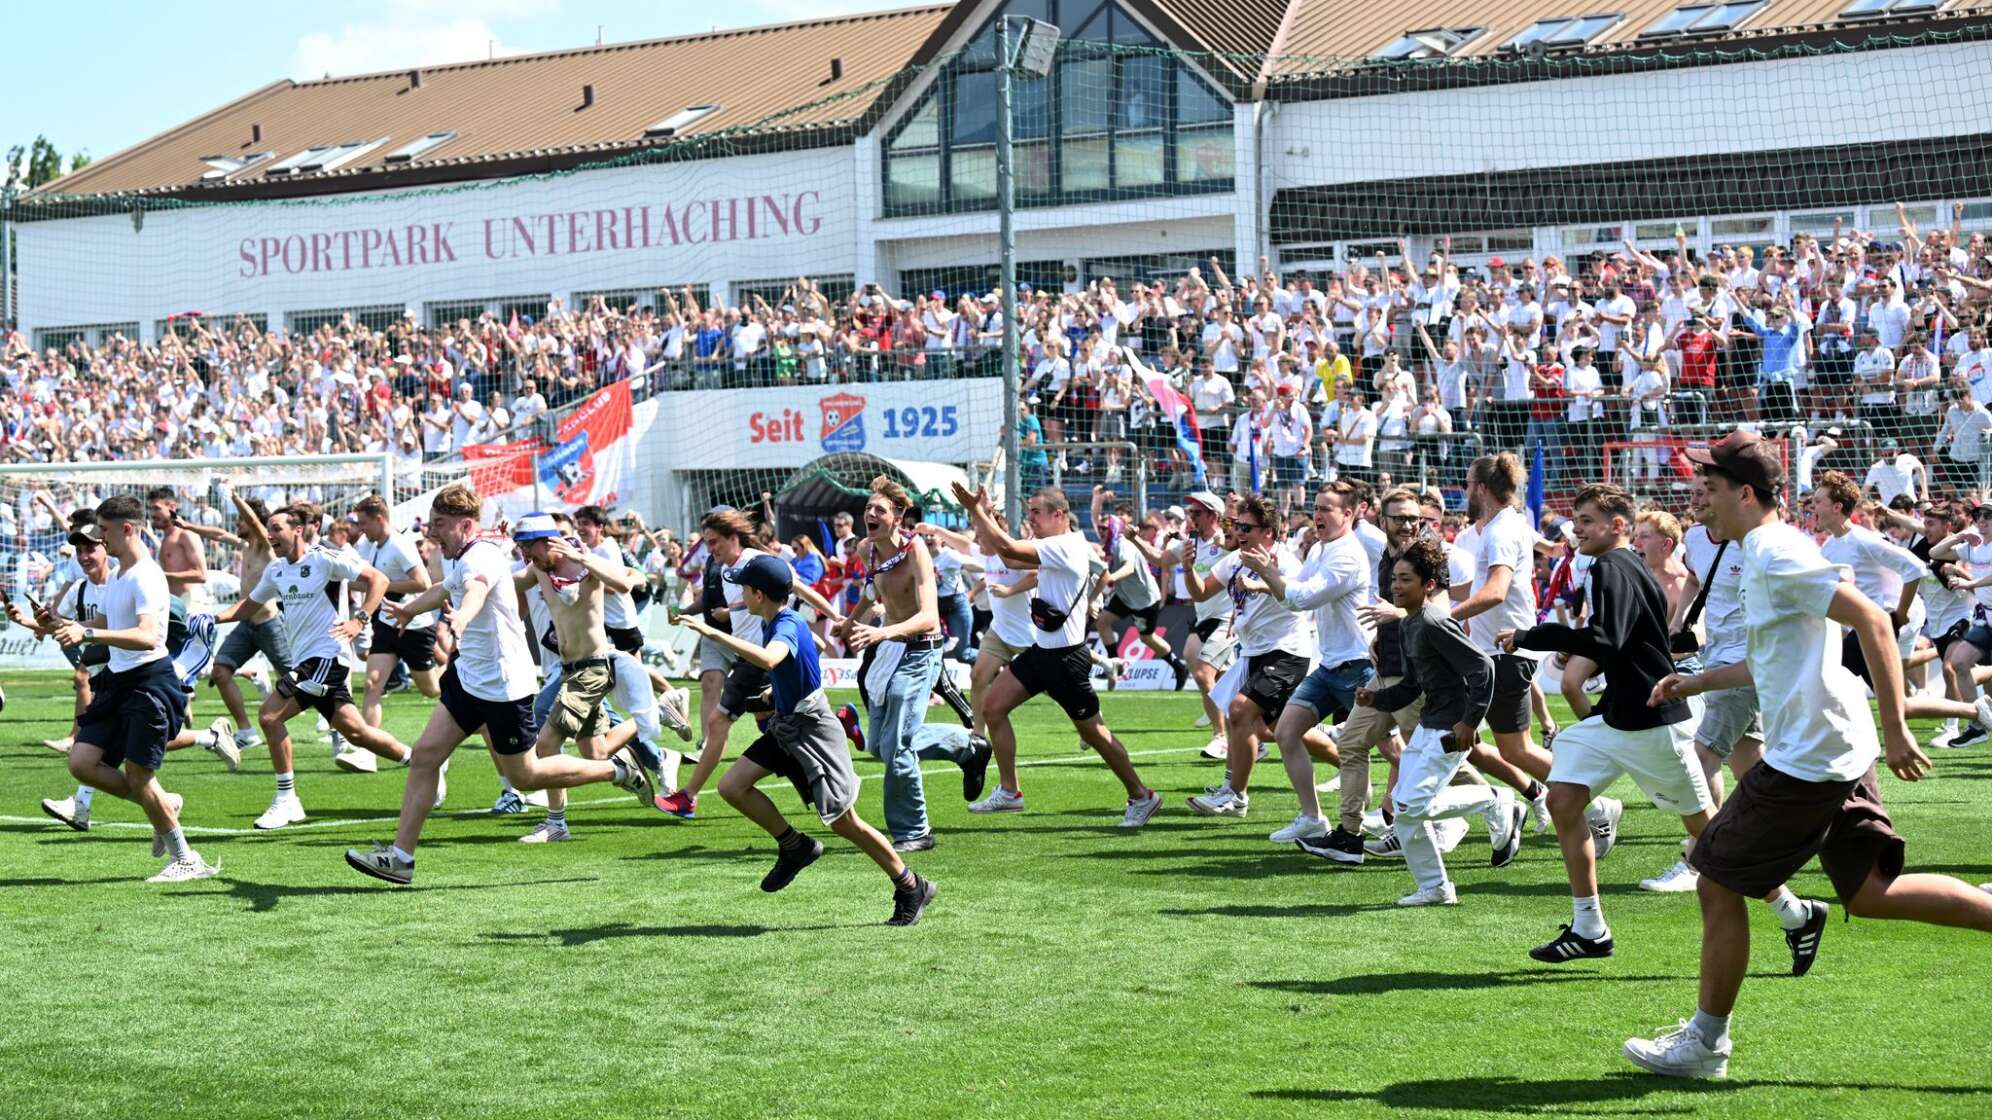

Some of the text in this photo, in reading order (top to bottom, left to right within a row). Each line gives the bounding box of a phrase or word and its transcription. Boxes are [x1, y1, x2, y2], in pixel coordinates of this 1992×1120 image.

[239, 190, 823, 278] SPORTPARK UNTERHACHING
[750, 405, 959, 444] Seit 1925
[377, 856, 391, 868] N
